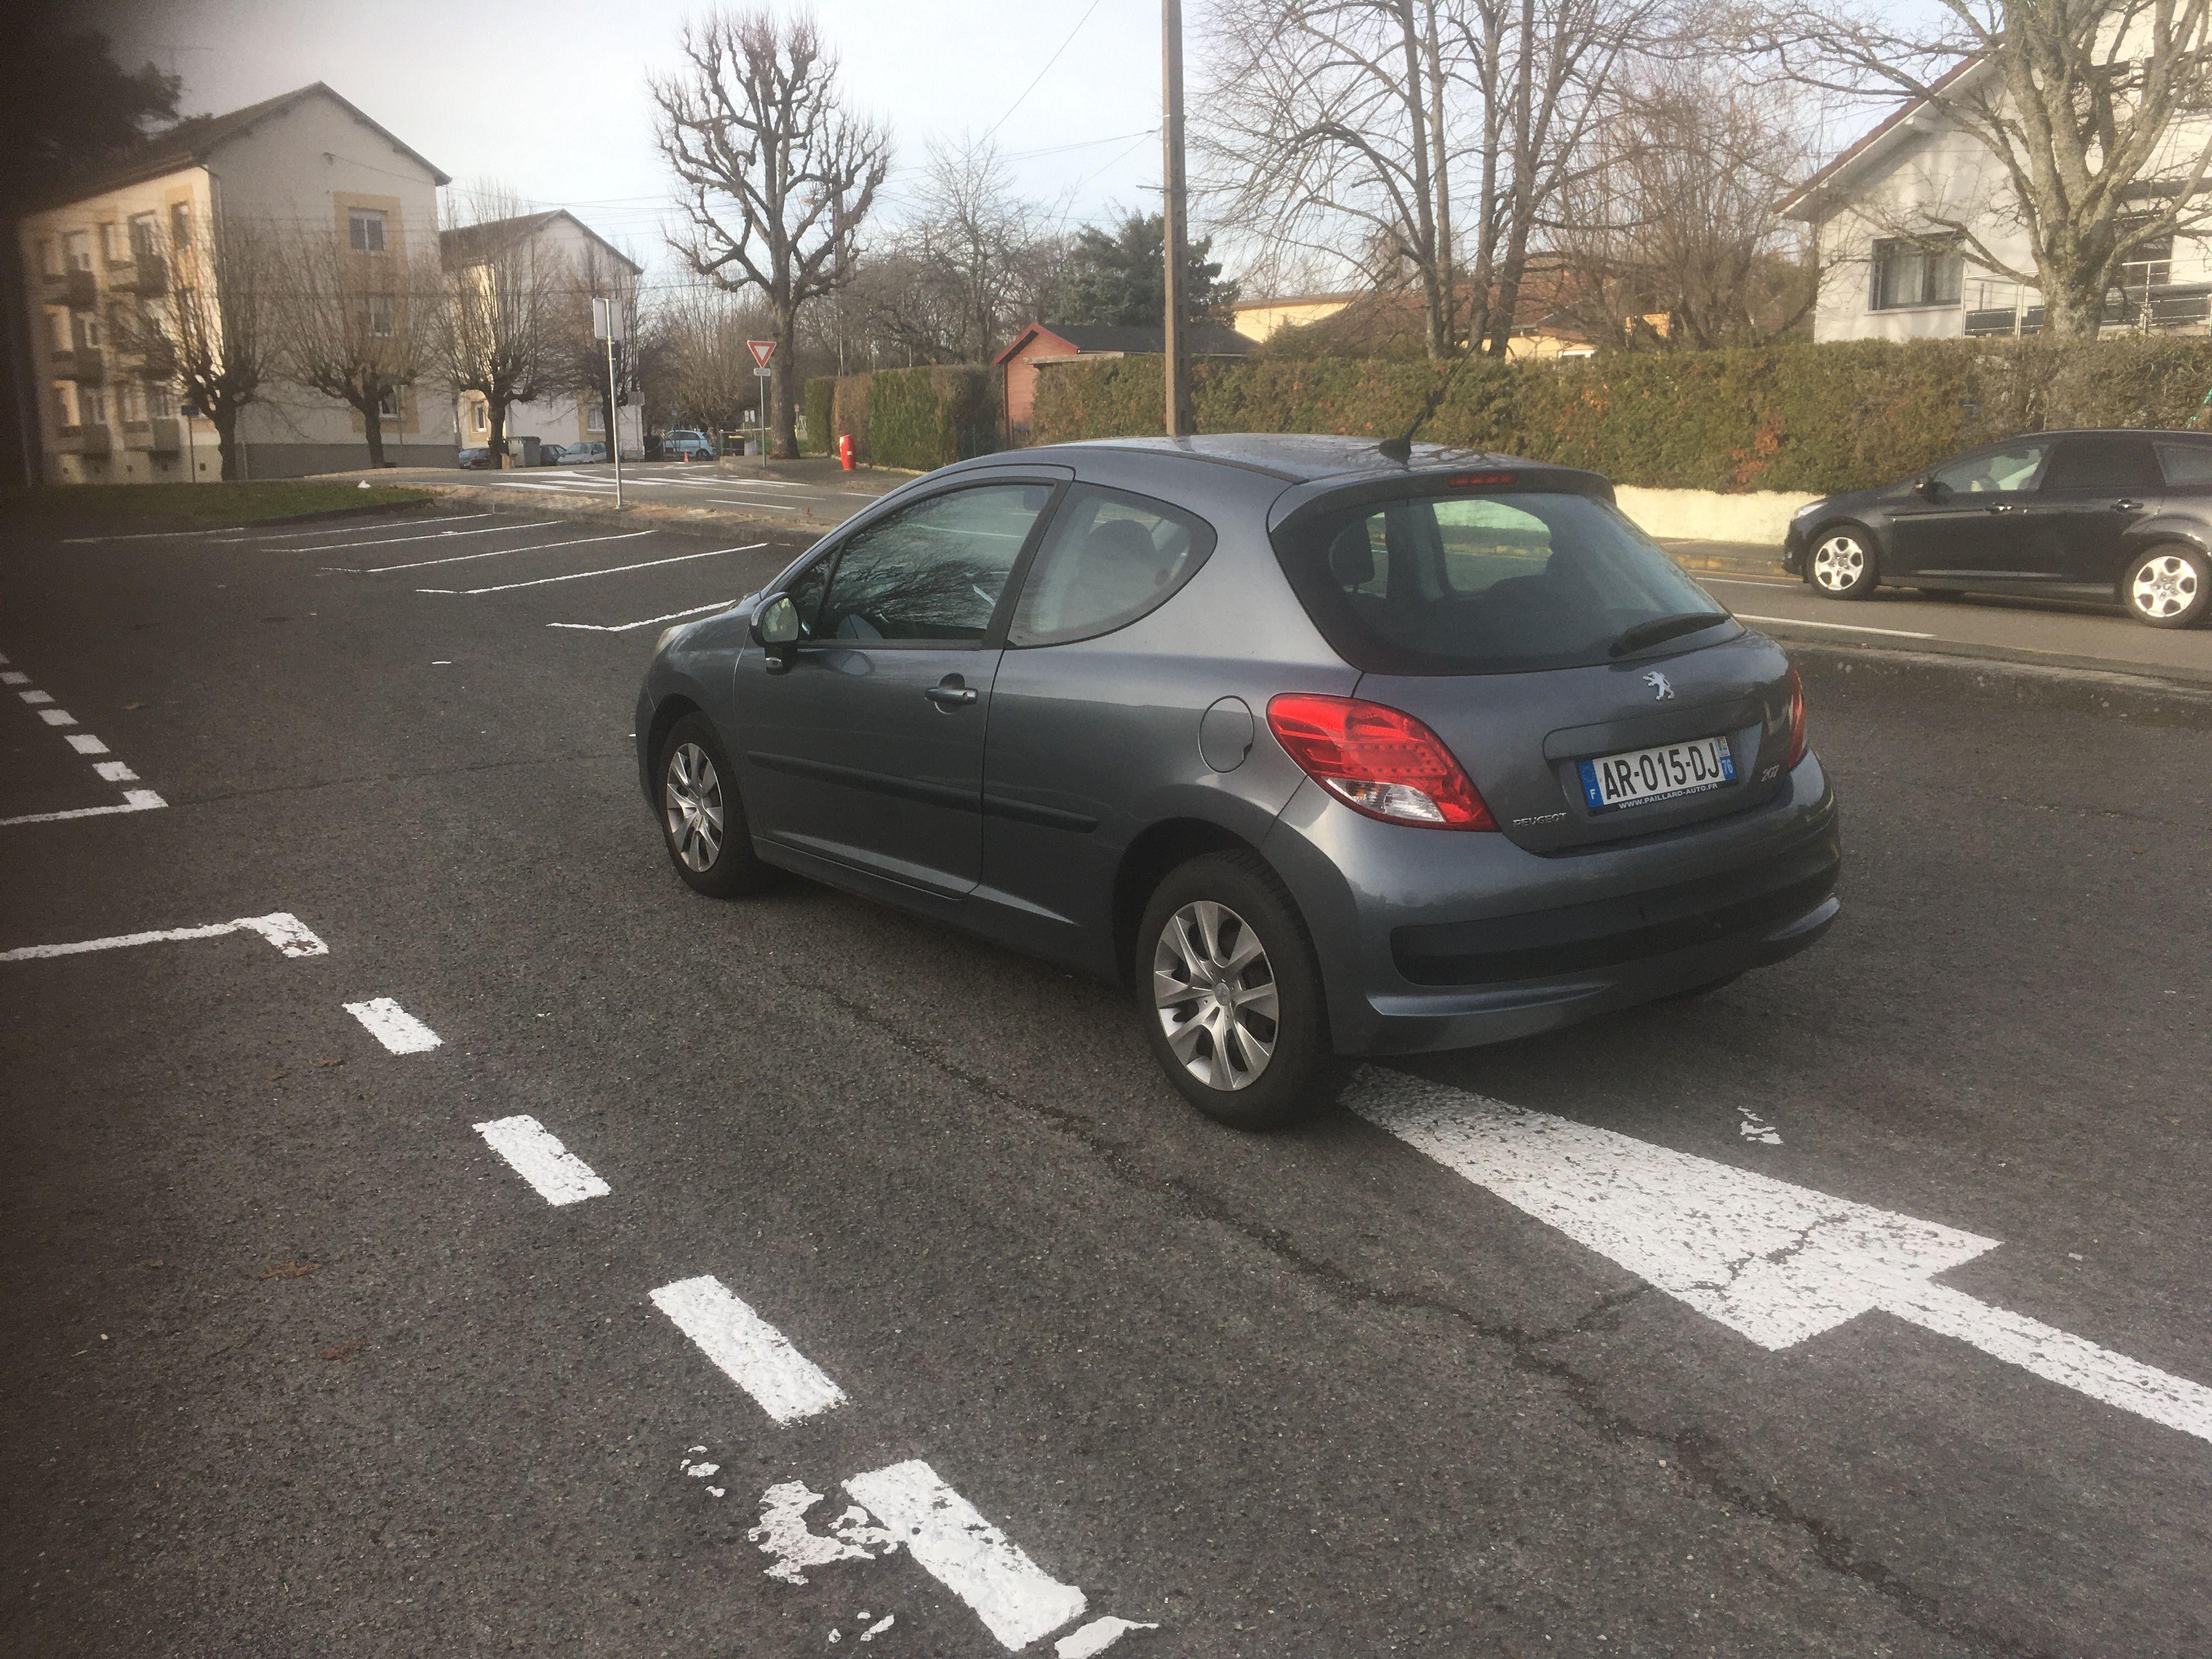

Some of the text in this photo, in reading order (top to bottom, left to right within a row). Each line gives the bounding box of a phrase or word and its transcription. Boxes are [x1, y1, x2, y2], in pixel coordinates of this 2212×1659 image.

[1602, 742, 1719, 800] AR-015-DJ
[1722, 759, 1733, 774] 76
[1762, 765, 1780, 782] 207
[1590, 788, 1596, 800] F
[1618, 782, 1718, 809] WWW.PAILLARD-AUTO.FR
[1513, 812, 1567, 827] PEUGEOT
